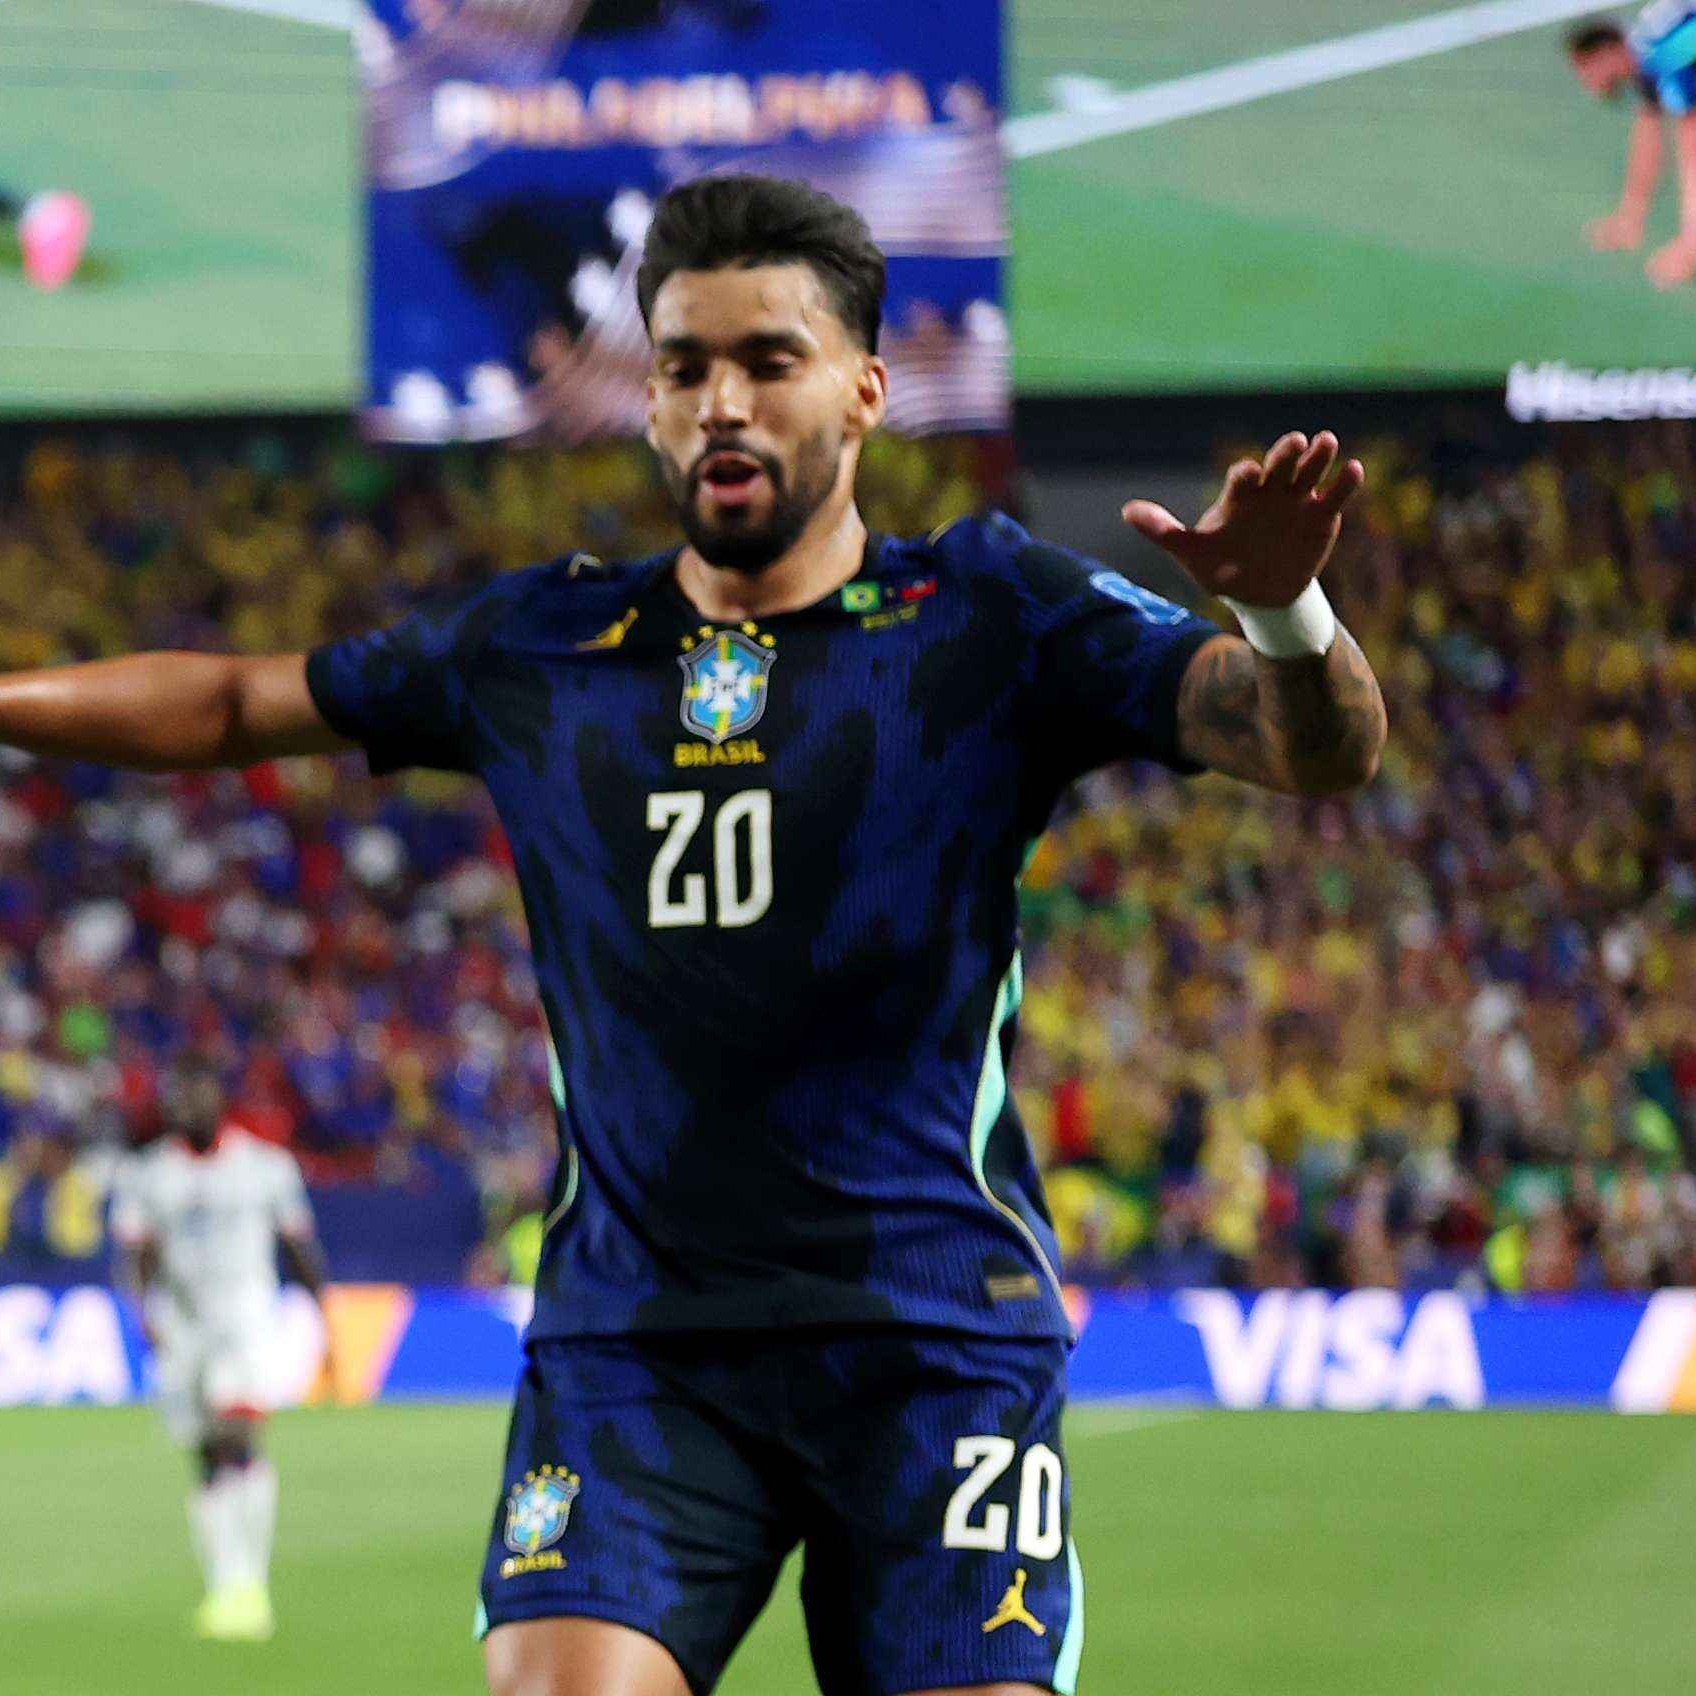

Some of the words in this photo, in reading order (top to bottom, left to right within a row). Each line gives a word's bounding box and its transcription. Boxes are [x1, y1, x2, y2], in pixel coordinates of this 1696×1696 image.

[673, 740, 766, 769] BRASIL
[646, 789, 773, 929] 20
[1175, 1288, 1487, 1411] VISA
[942, 1435, 1063, 1561] 20
